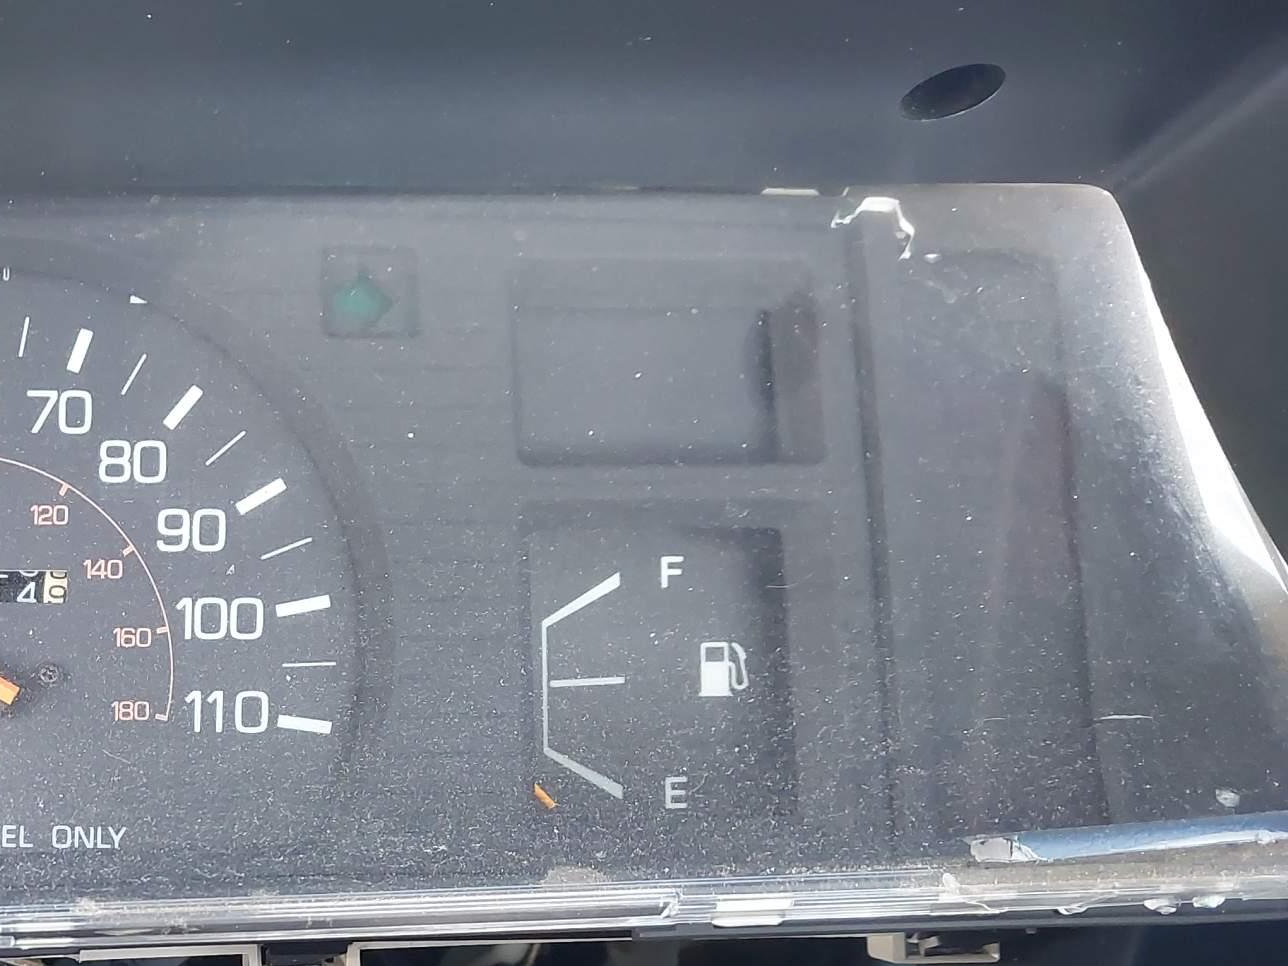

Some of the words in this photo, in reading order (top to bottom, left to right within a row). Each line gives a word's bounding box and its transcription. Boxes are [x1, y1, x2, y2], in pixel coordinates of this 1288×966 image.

[26, 389, 93, 435] 70
[98, 439, 167, 484] 80
[29, 504, 70, 526] 120
[156, 508, 227, 553] 90
[82, 558, 124, 580] 140
[660, 555, 685, 588] F
[174, 596, 264, 640] 100
[112, 627, 152, 648] 160
[111, 700, 150, 721] 180
[184, 690, 269, 734] 110
[664, 776, 688, 809] E
[51, 824, 127, 850] ONLY
